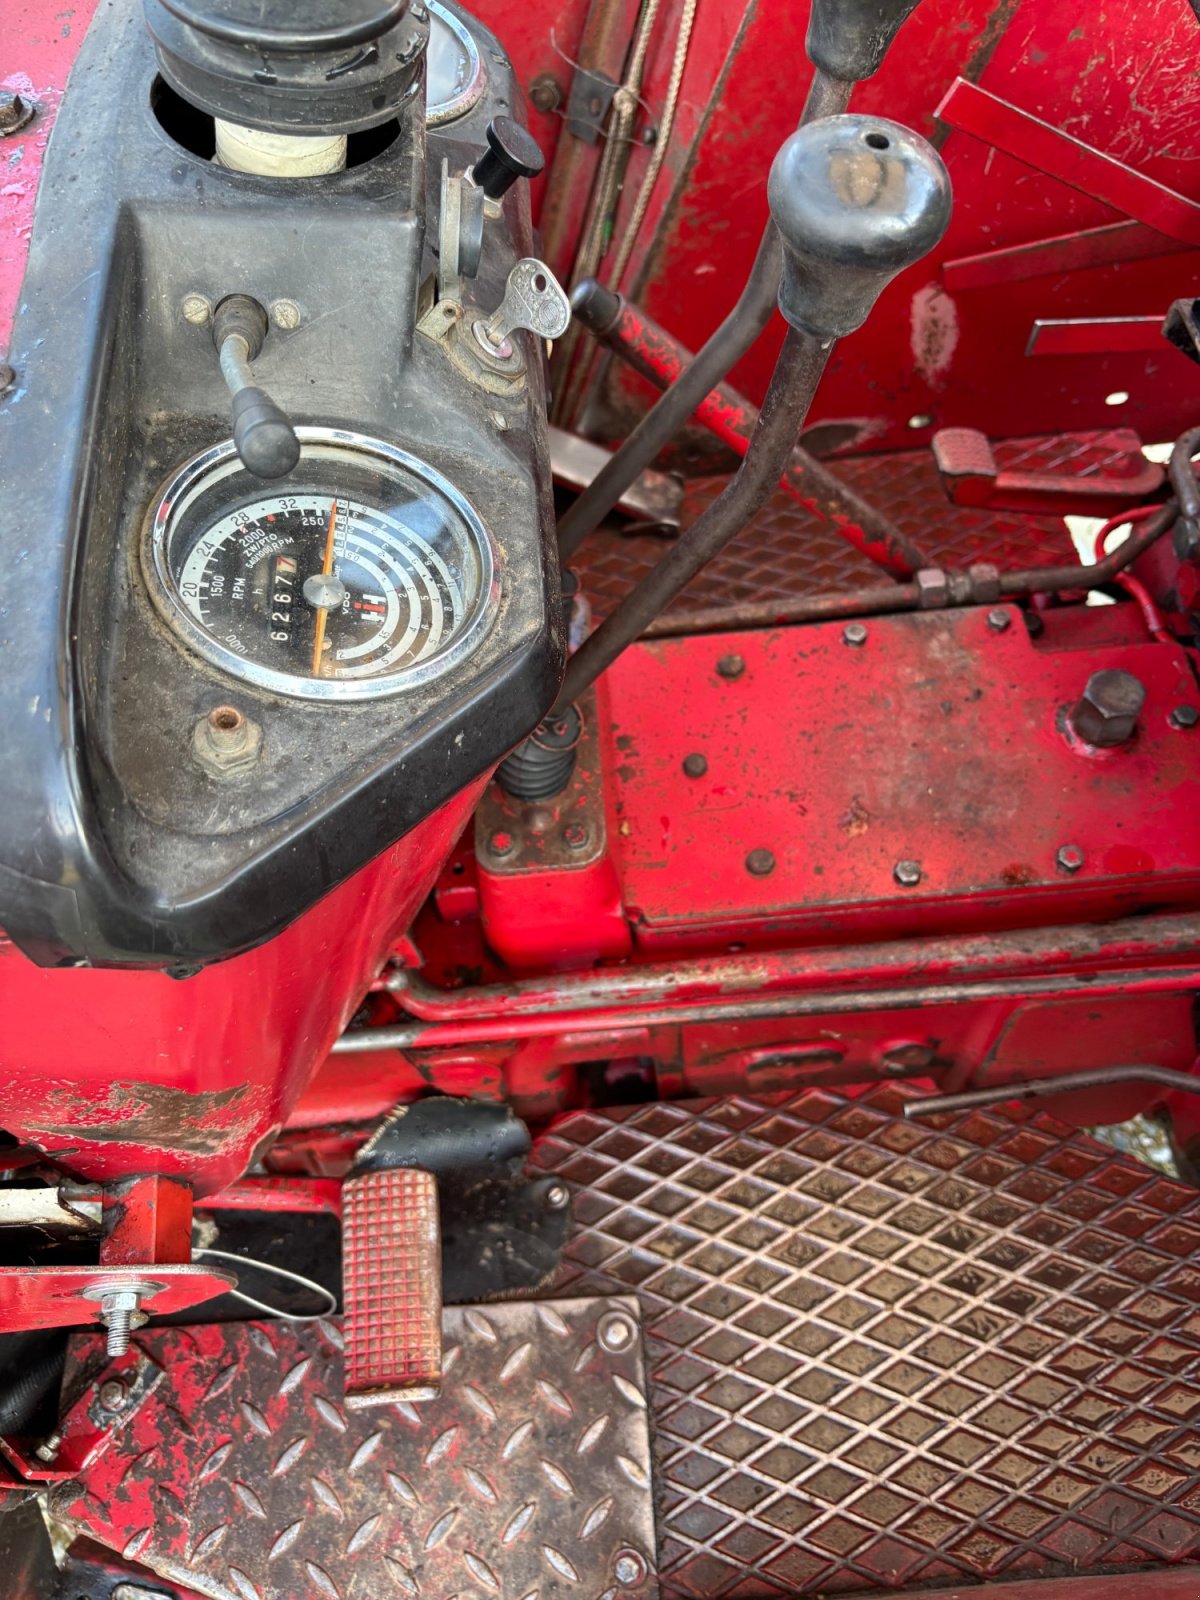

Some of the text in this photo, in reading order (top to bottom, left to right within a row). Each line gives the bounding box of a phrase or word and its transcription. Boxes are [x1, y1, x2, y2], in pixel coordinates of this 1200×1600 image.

[278, 498, 298, 510] 32
[230, 512, 250, 527] 28
[239, 528, 266, 547] 2000
[243, 533, 277, 557] ZW/PTO
[196, 541, 215, 557] 24
[182, 582, 198, 598] 20
[210, 575, 225, 597] 1500
[232, 577, 246, 600] RPM
[342, 591, 351, 615] VDO
[381, 657, 389, 665] 5
